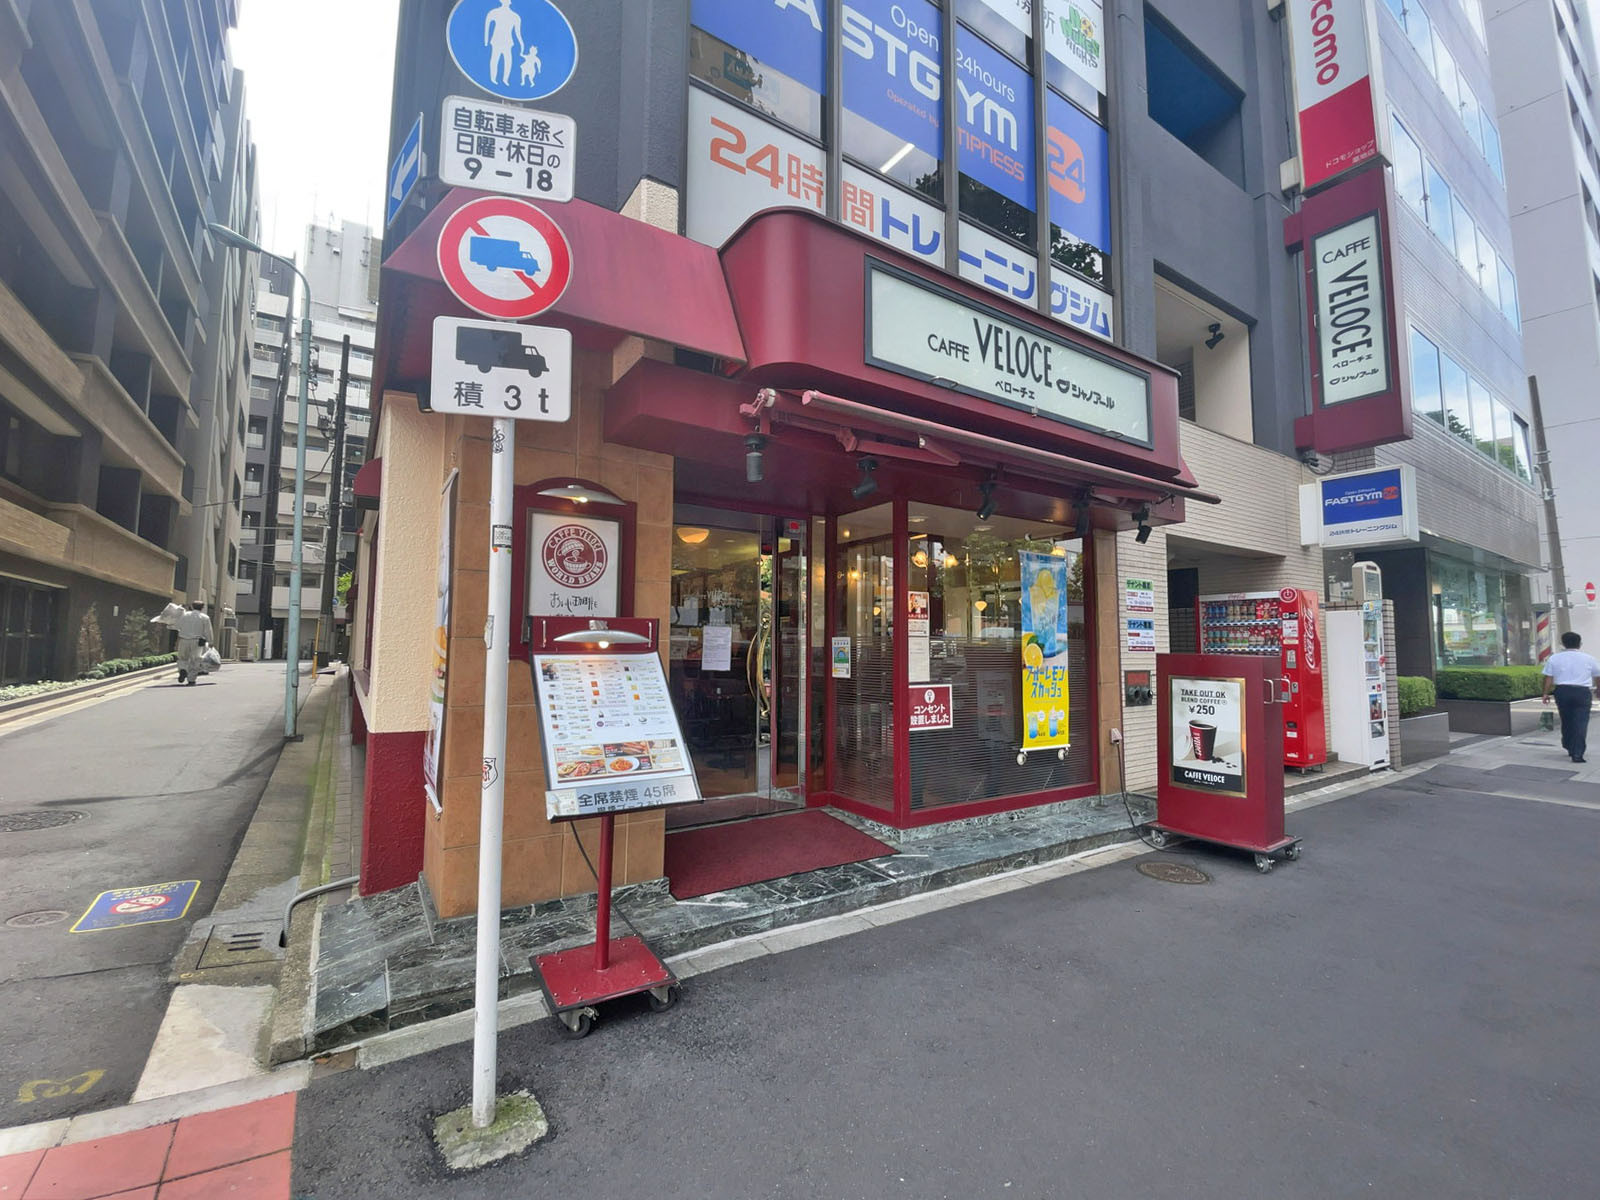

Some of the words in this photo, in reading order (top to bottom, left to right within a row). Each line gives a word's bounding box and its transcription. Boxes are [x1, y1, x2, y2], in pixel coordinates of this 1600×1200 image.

[891, 5, 939, 51] Open
[956, 47, 1016, 103] 24hours
[454, 107, 564, 145] 自転車を除く
[457, 133, 561, 168] 日曜・休日の
[958, 128, 1025, 182] TIPNESS
[1047, 140, 1086, 189] 24
[1322, 237, 1371, 264] CAFFE
[1329, 259, 1373, 358] VELOCE
[927, 333, 970, 362] CAFFE
[973, 318, 1053, 388] VELOCE
[1331, 354, 1373, 368] ベローチェ
[995, 380, 1035, 400] ベローチェ
[1325, 490, 1383, 507] FASTGYM
[547, 528, 576, 549] CAFFE
[547, 558, 576, 584] WORLD
[578, 561, 604, 584] BEANS
[910, 713, 949, 725] 設置しました
[913, 704, 946, 714] コンセント
[1189, 704, 1215, 715] ¥250
[1184, 770, 1201, 780] CAFFE
[1202, 773, 1225, 783] VELOCE
[578, 788, 639, 808] 全席禁煙
[643, 784, 677, 799] 45席
